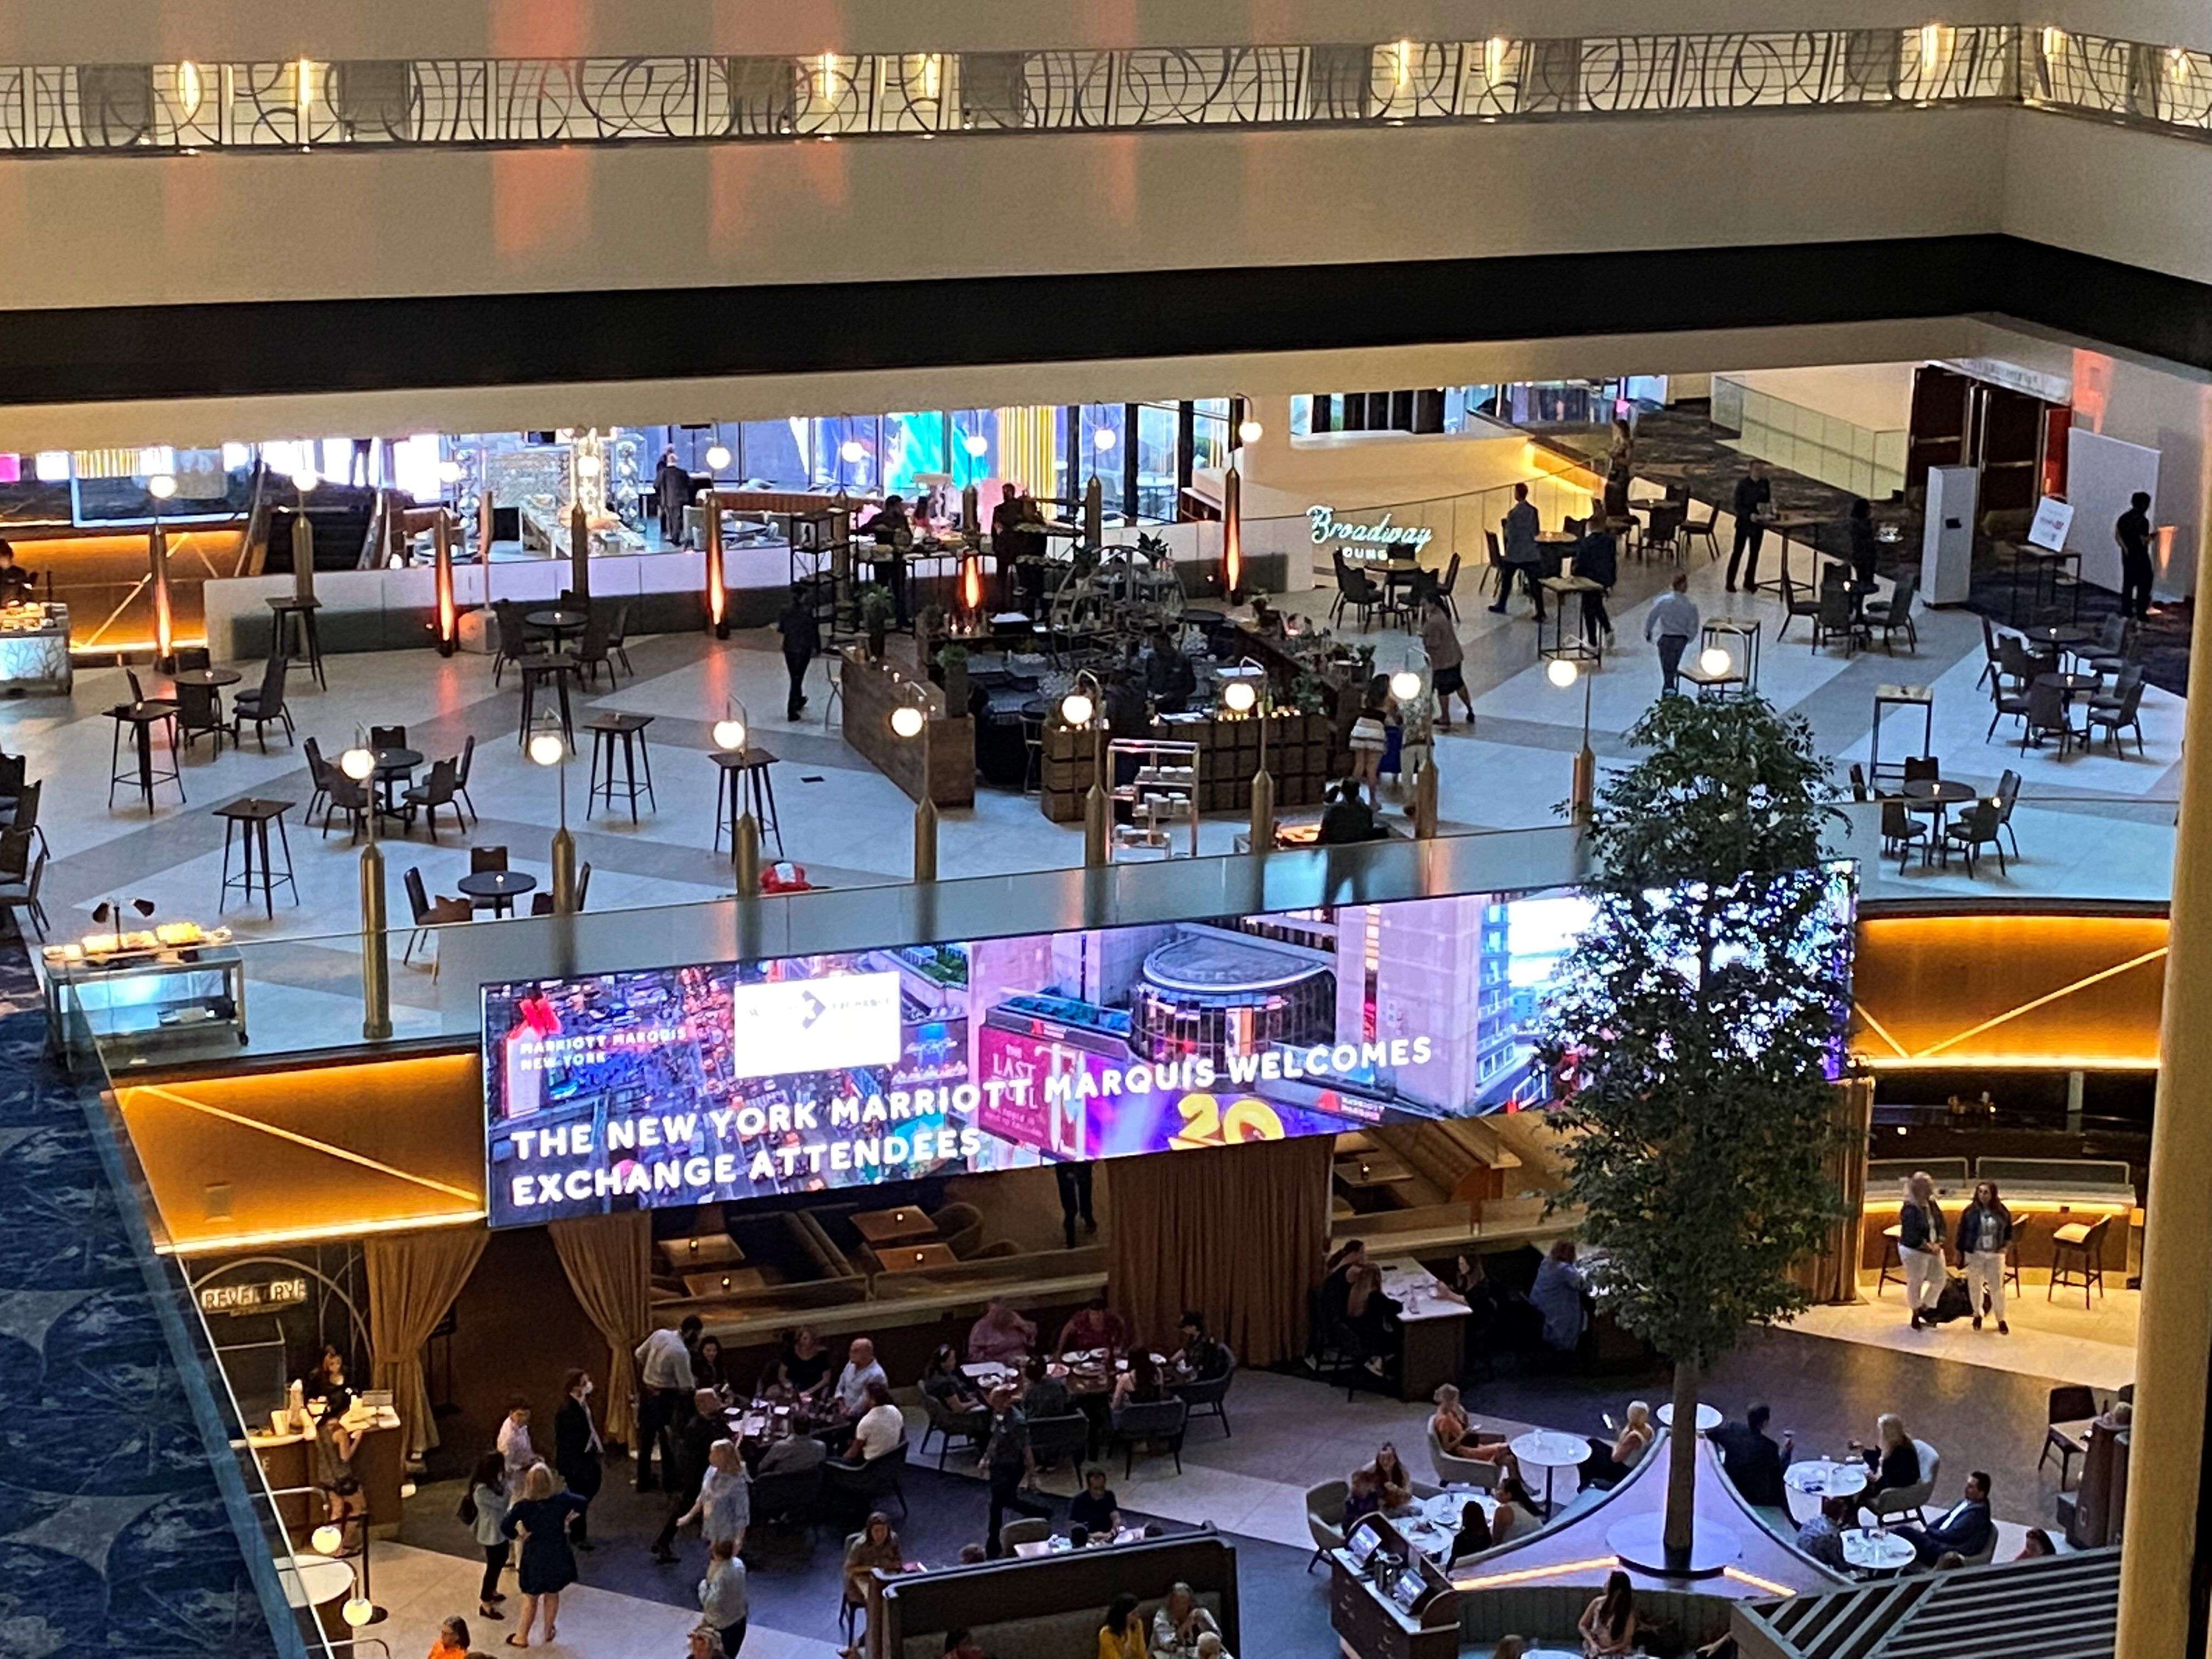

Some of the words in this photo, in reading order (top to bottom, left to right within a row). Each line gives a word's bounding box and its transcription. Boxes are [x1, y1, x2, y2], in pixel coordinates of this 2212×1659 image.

[1306, 505, 1432, 553] Broadway
[1336, 546, 1389, 560] OUNG
[520, 1034, 607, 1054] MARRIOTT
[612, 1026, 686, 1046] MARQUIS
[520, 1056, 557, 1071] NEW
[563, 1051, 606, 1068] YORK
[510, 1124, 593, 1160] THE
[607, 1113, 697, 1150] NEW
[708, 1100, 817, 1138] YORK
[831, 1078, 1032, 1126] MARRIOTT
[1045, 1058, 1216, 1103] MARQUIS
[1227, 1036, 1432, 1084] WELCOMES
[512, 1154, 737, 1206] EXCHANGE
[748, 1126, 981, 1180] ATTENDEES
